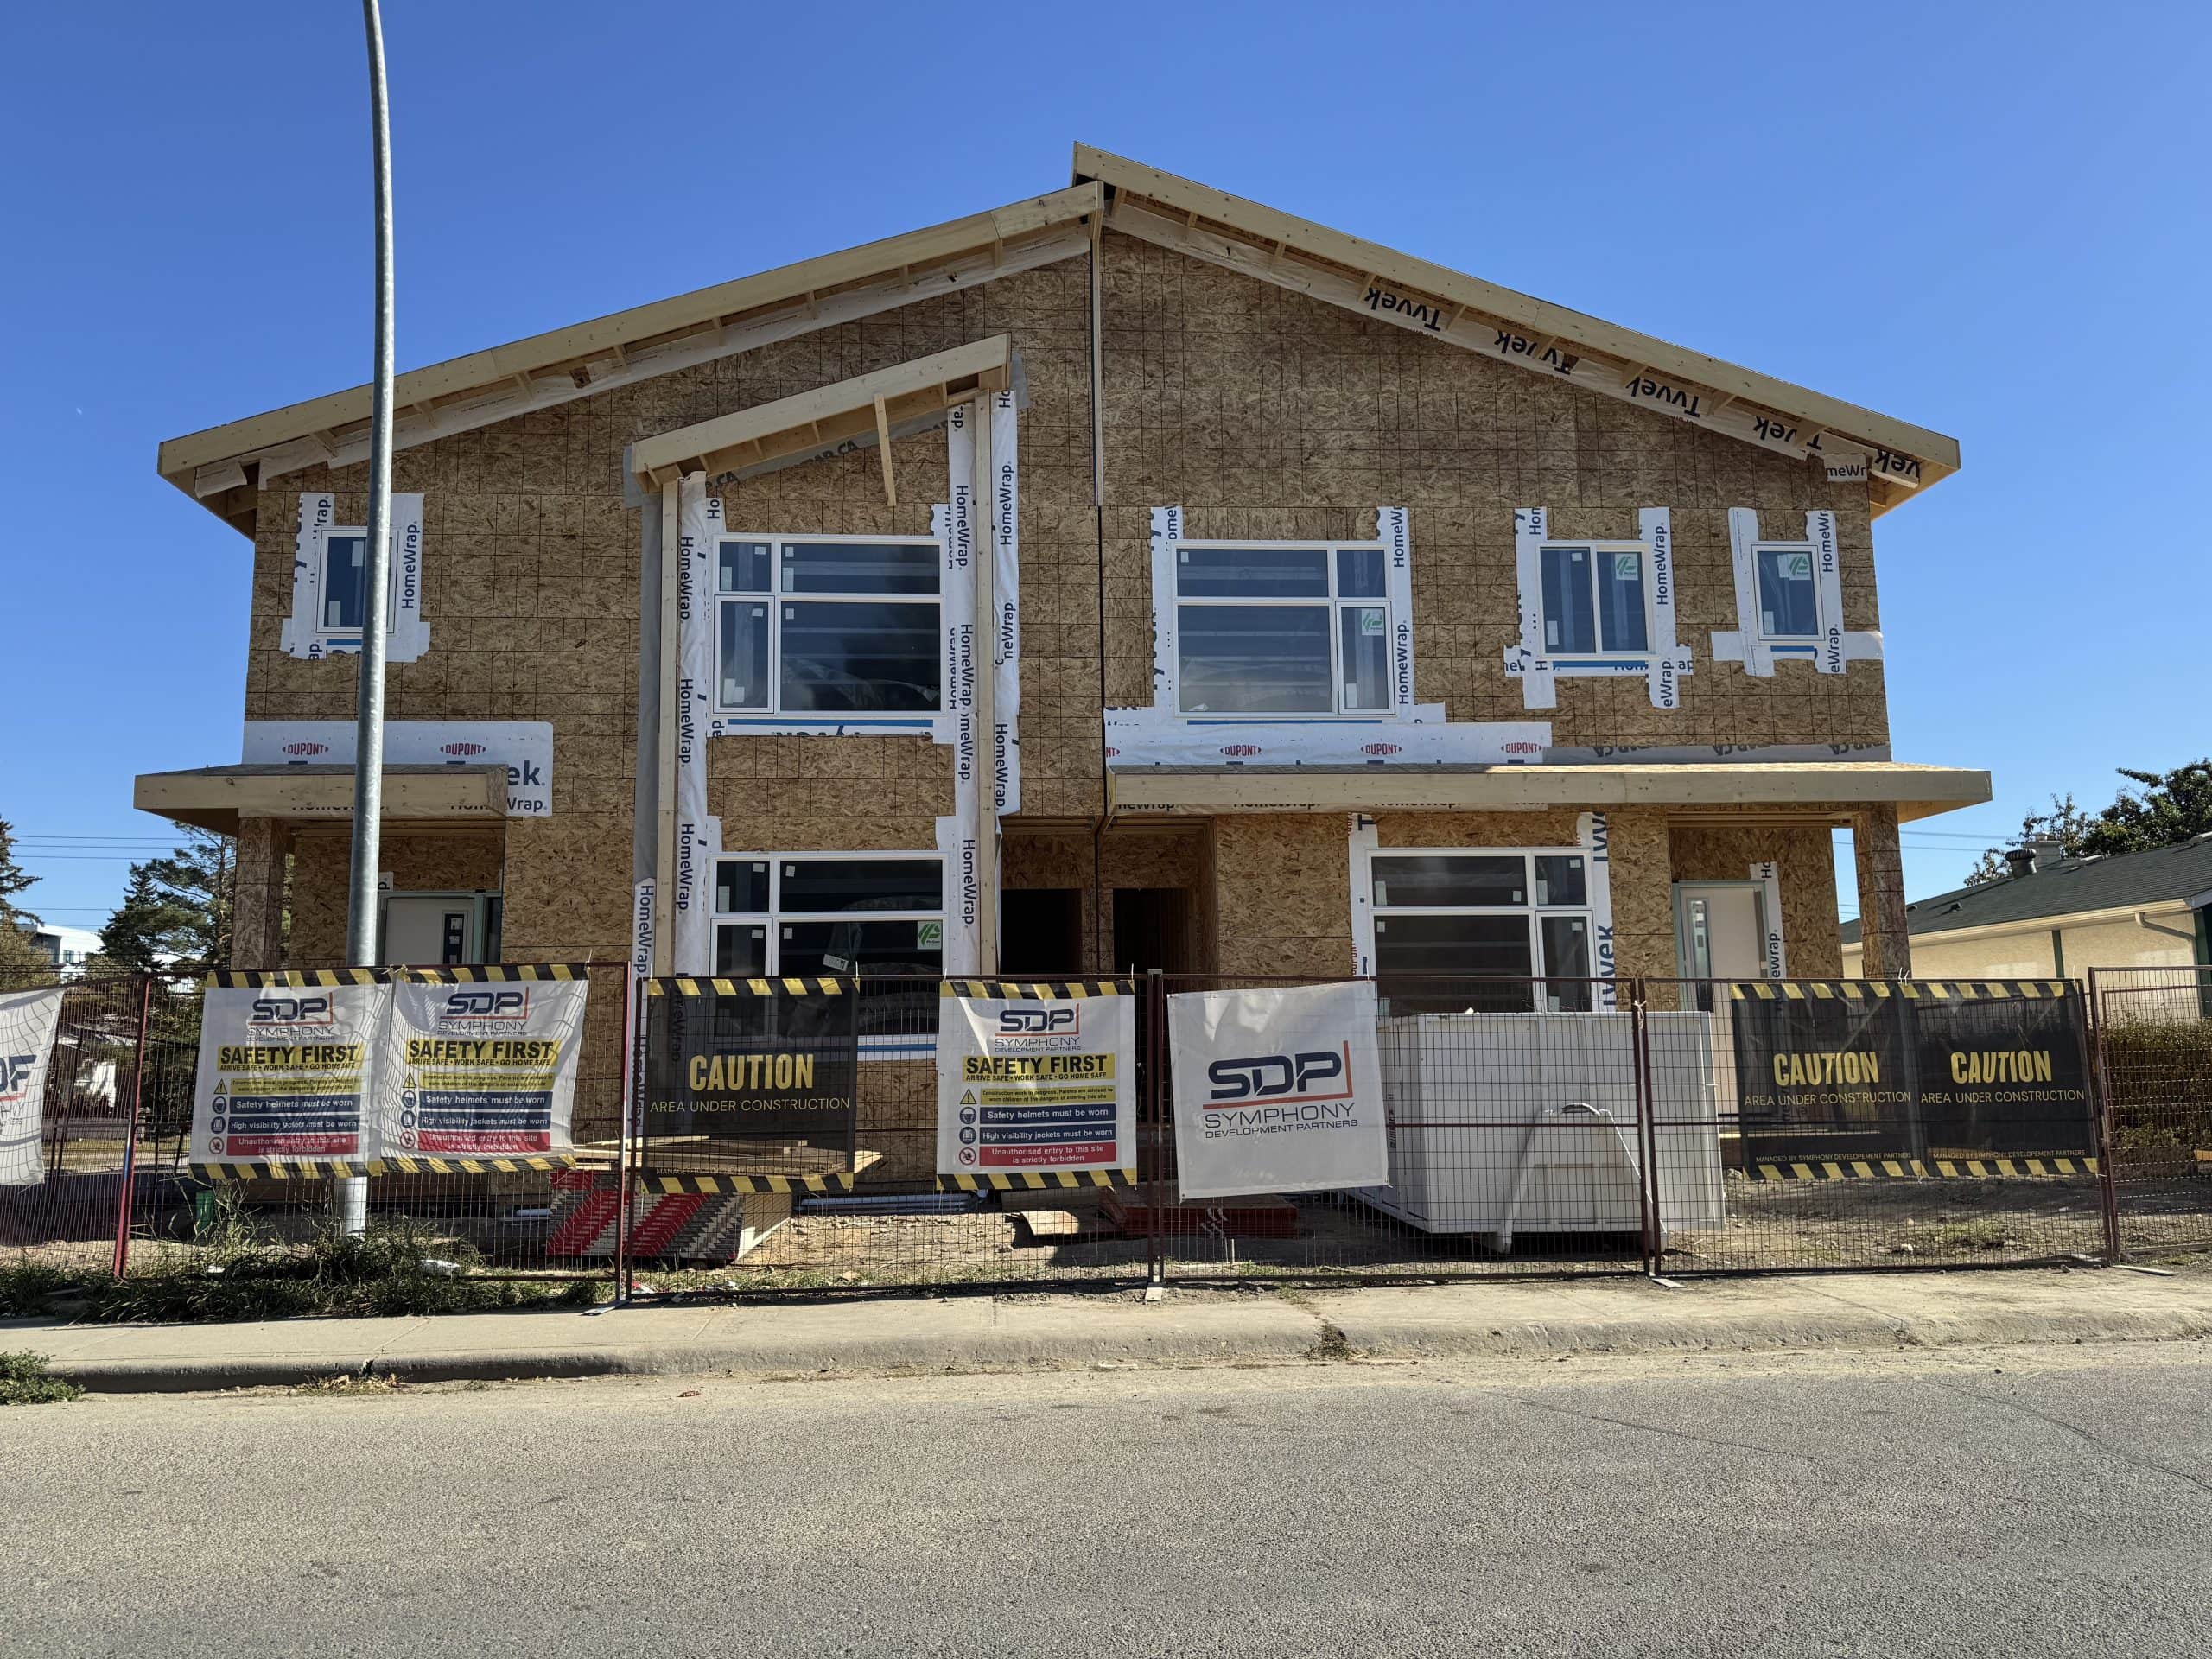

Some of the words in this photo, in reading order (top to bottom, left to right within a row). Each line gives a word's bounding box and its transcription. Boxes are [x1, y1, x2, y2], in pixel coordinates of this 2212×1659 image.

[288, 742, 325, 755] DUPONT
[445, 742, 482, 755] DUPONT
[1225, 744, 1257, 756] DUPONT
[1365, 743, 1397, 755] DUPONT
[1506, 742, 1537, 754] DUPONT
[253, 997, 327, 1020] SDP
[447, 992, 524, 1014] SDP
[438, 1021, 528, 1031] SYMPHONY
[1000, 1009, 1075, 1032] SDP
[409, 1040, 486, 1058] SAFETY
[493, 1041, 553, 1059] FIRST
[995, 1037, 1080, 1047] SYMPHONY
[221, 1047, 295, 1064] SAFETY
[303, 1046, 358, 1063] FIRST
[690, 1053, 814, 1091] CAUTION
[966, 1056, 1043, 1074] SAFETY
[1050, 1055, 1107, 1073] FIRST
[1773, 1051, 1879, 1086] CAUTION
[1951, 1051, 2053, 1084] CAUTION
[1208, 1051, 1341, 1099] SDP
[427, 1096, 453, 1104] Safety
[1745, 1095, 1775, 1106] AREA
[1778, 1094, 1816, 1106] UNDER
[1820, 1091, 1910, 1103] CONSTRUCTION
[1921, 1092, 1951, 1103] AREA
[1956, 1092, 1991, 1103] UNDER
[1994, 1090, 2084, 1103] CONSTRUCTION
[236, 1101, 263, 1109] Safety
[650, 1101, 685, 1113] AREA
[690, 1100, 736, 1113] UNDER
[741, 1097, 849, 1111] CONSTRUCTION
[988, 1110, 1014, 1120] Safety
[1205, 1103, 1355, 1128] SYMPHONY
[1002, 1131, 1033, 1140] visibility
[1034, 1131, 1061, 1140] jackets
[1206, 1125, 1293, 1139] DEVELOPMENT
[1296, 1120, 1358, 1131] PARTNERS
[992, 1147, 1041, 1155] Unauthorised
[1045, 1147, 1063, 1155] entry
